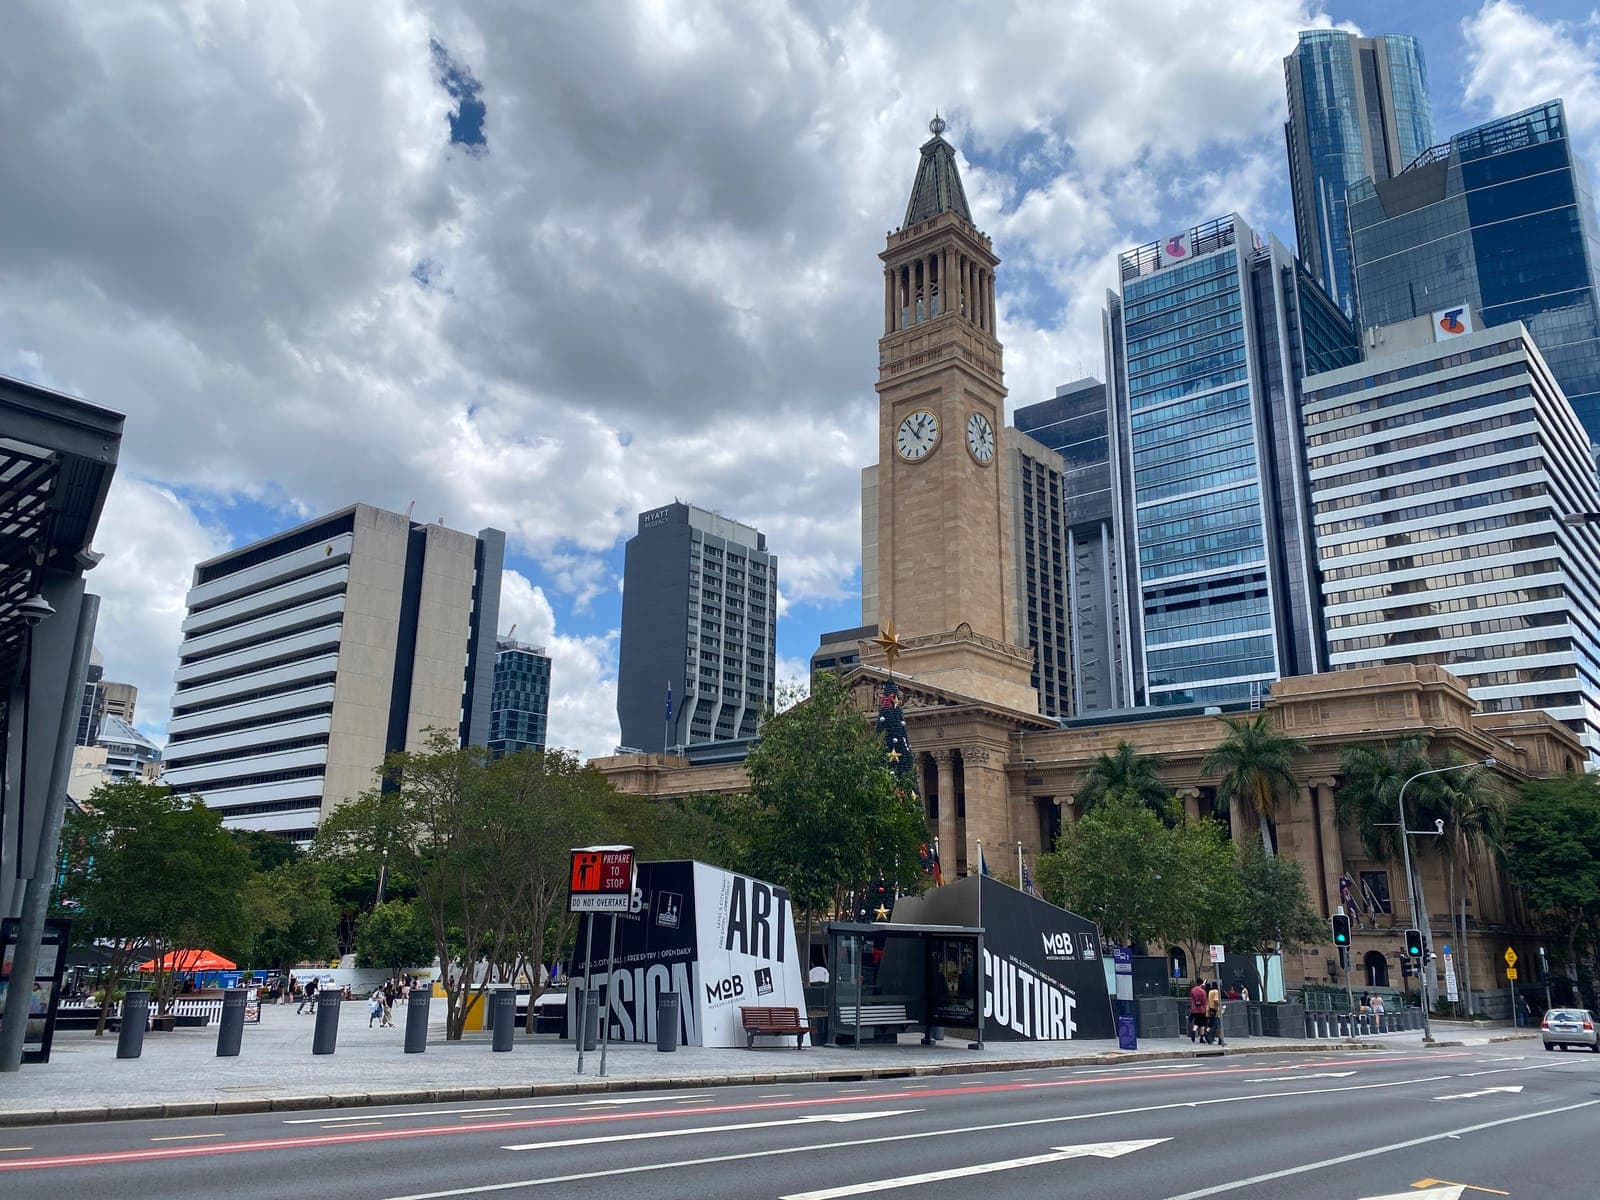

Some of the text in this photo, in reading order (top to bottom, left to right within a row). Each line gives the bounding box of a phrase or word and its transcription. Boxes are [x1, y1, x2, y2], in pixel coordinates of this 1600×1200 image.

[646, 509, 669, 522] HYATT
[603, 854, 630, 864] PREPARE
[610, 866, 620, 876] TO
[606, 878, 624, 889] STOP
[572, 898, 627, 907] DO NOT OVERTAKE
[726, 876, 791, 963] ART
[627, 953, 640, 962] FREE
[661, 949, 676, 958] OPEN
[676, 947, 692, 956] DAILY
